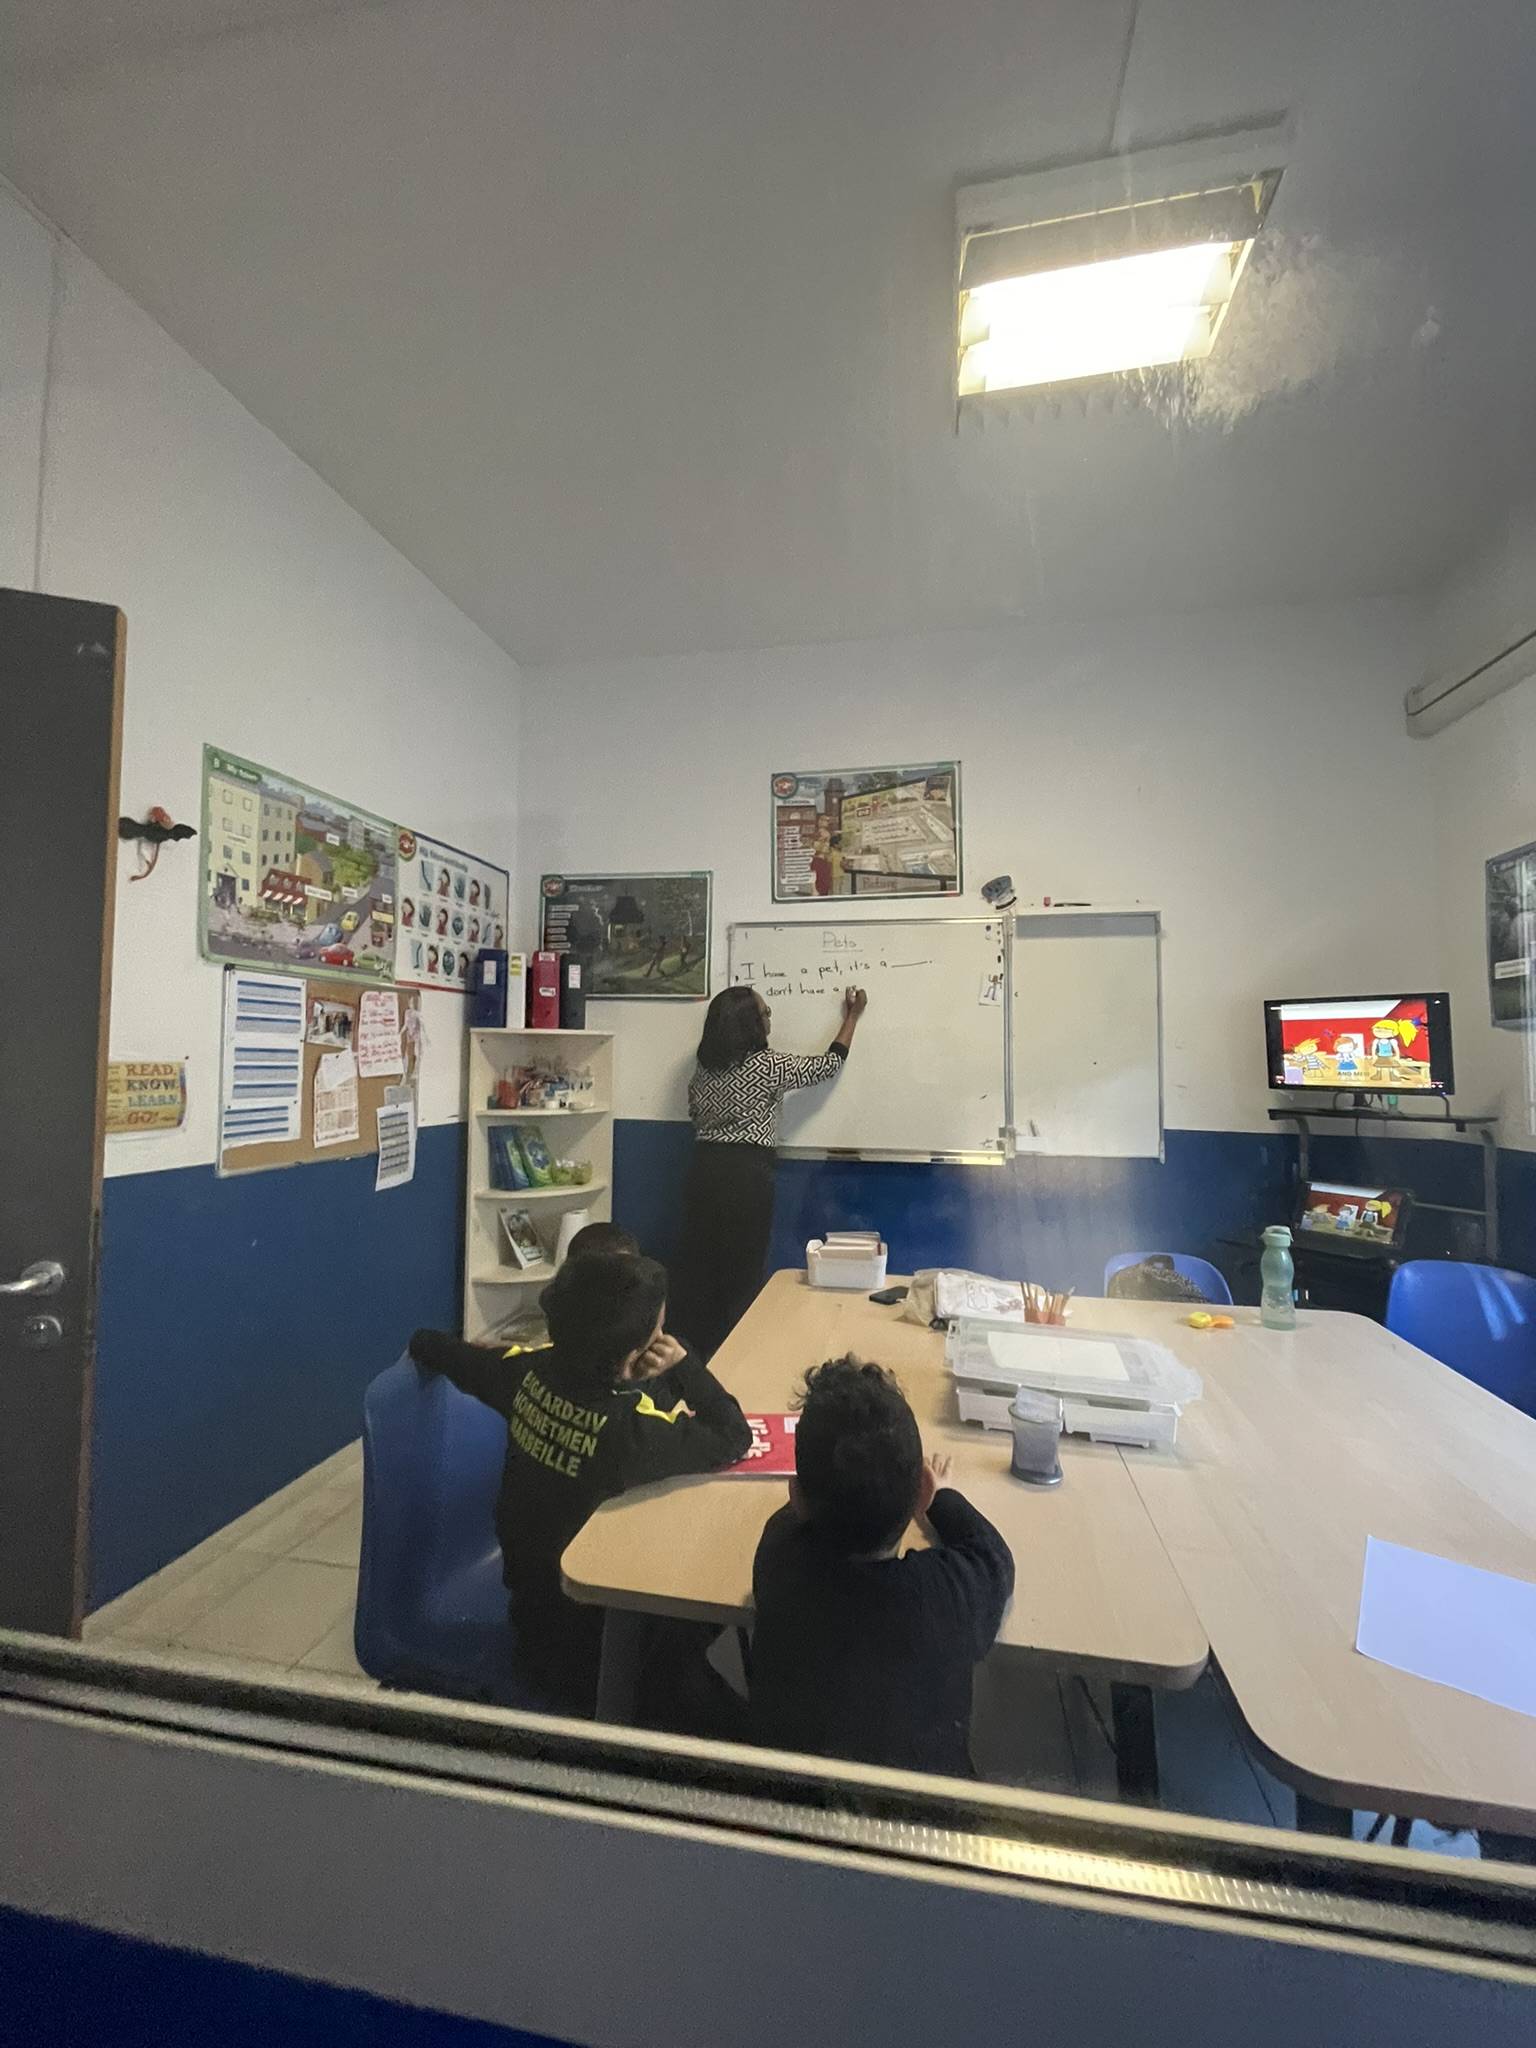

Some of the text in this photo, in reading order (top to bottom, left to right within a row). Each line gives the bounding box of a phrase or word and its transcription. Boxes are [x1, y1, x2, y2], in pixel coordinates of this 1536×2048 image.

[823, 930, 857, 949] Pets
[741, 962, 755, 980] I
[766, 983, 792, 996] don't
[800, 982, 824, 994] have
[126, 1063, 176, 1076] READ.
